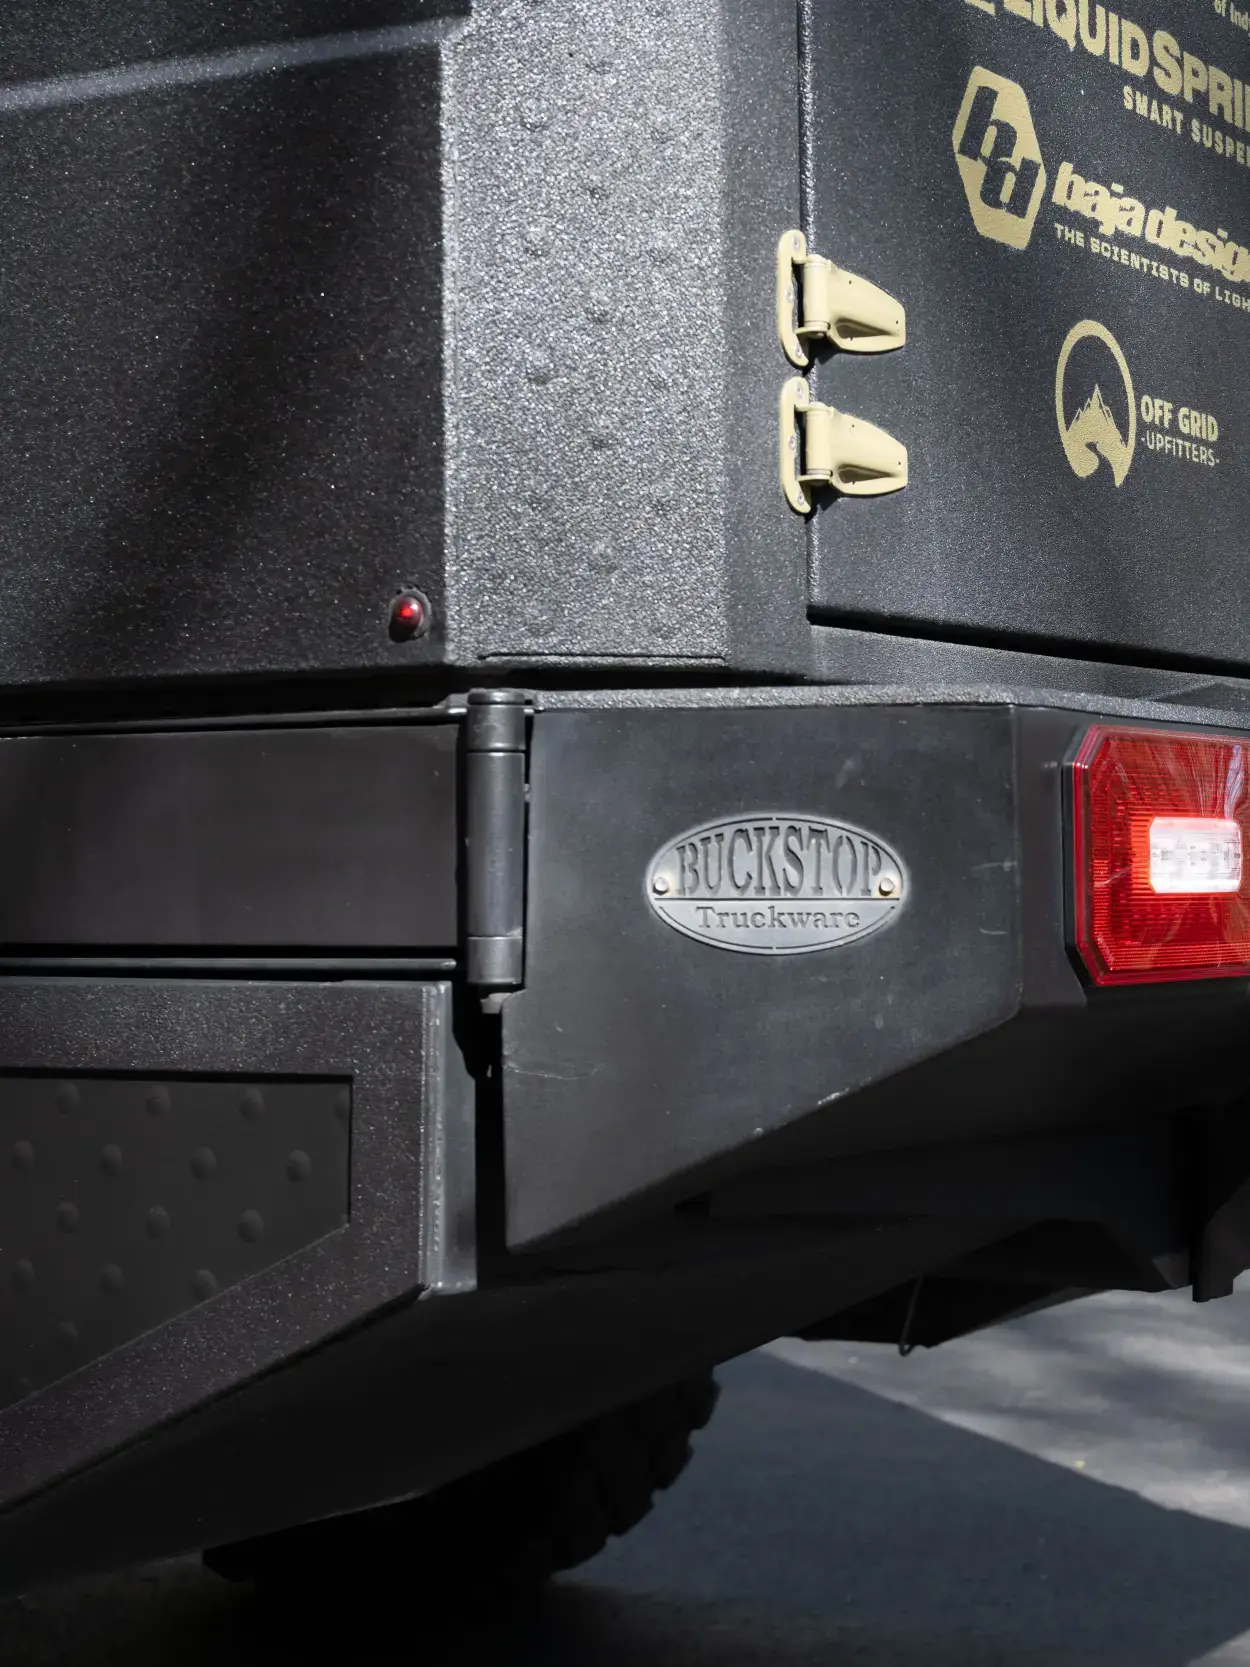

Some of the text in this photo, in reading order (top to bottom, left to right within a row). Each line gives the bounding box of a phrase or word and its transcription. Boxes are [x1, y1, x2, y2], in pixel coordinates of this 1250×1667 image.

[1122, 86, 1184, 135] SMART
[1054, 223, 1085, 248] THE
[1090, 237, 1189, 288] SCIENTISTS
[1193, 278, 1211, 297] OF
[1140, 394, 1219, 441] OFF GRID
[675, 825, 882, 897] BUCKSTOP
[696, 905, 860, 929] Truckware
